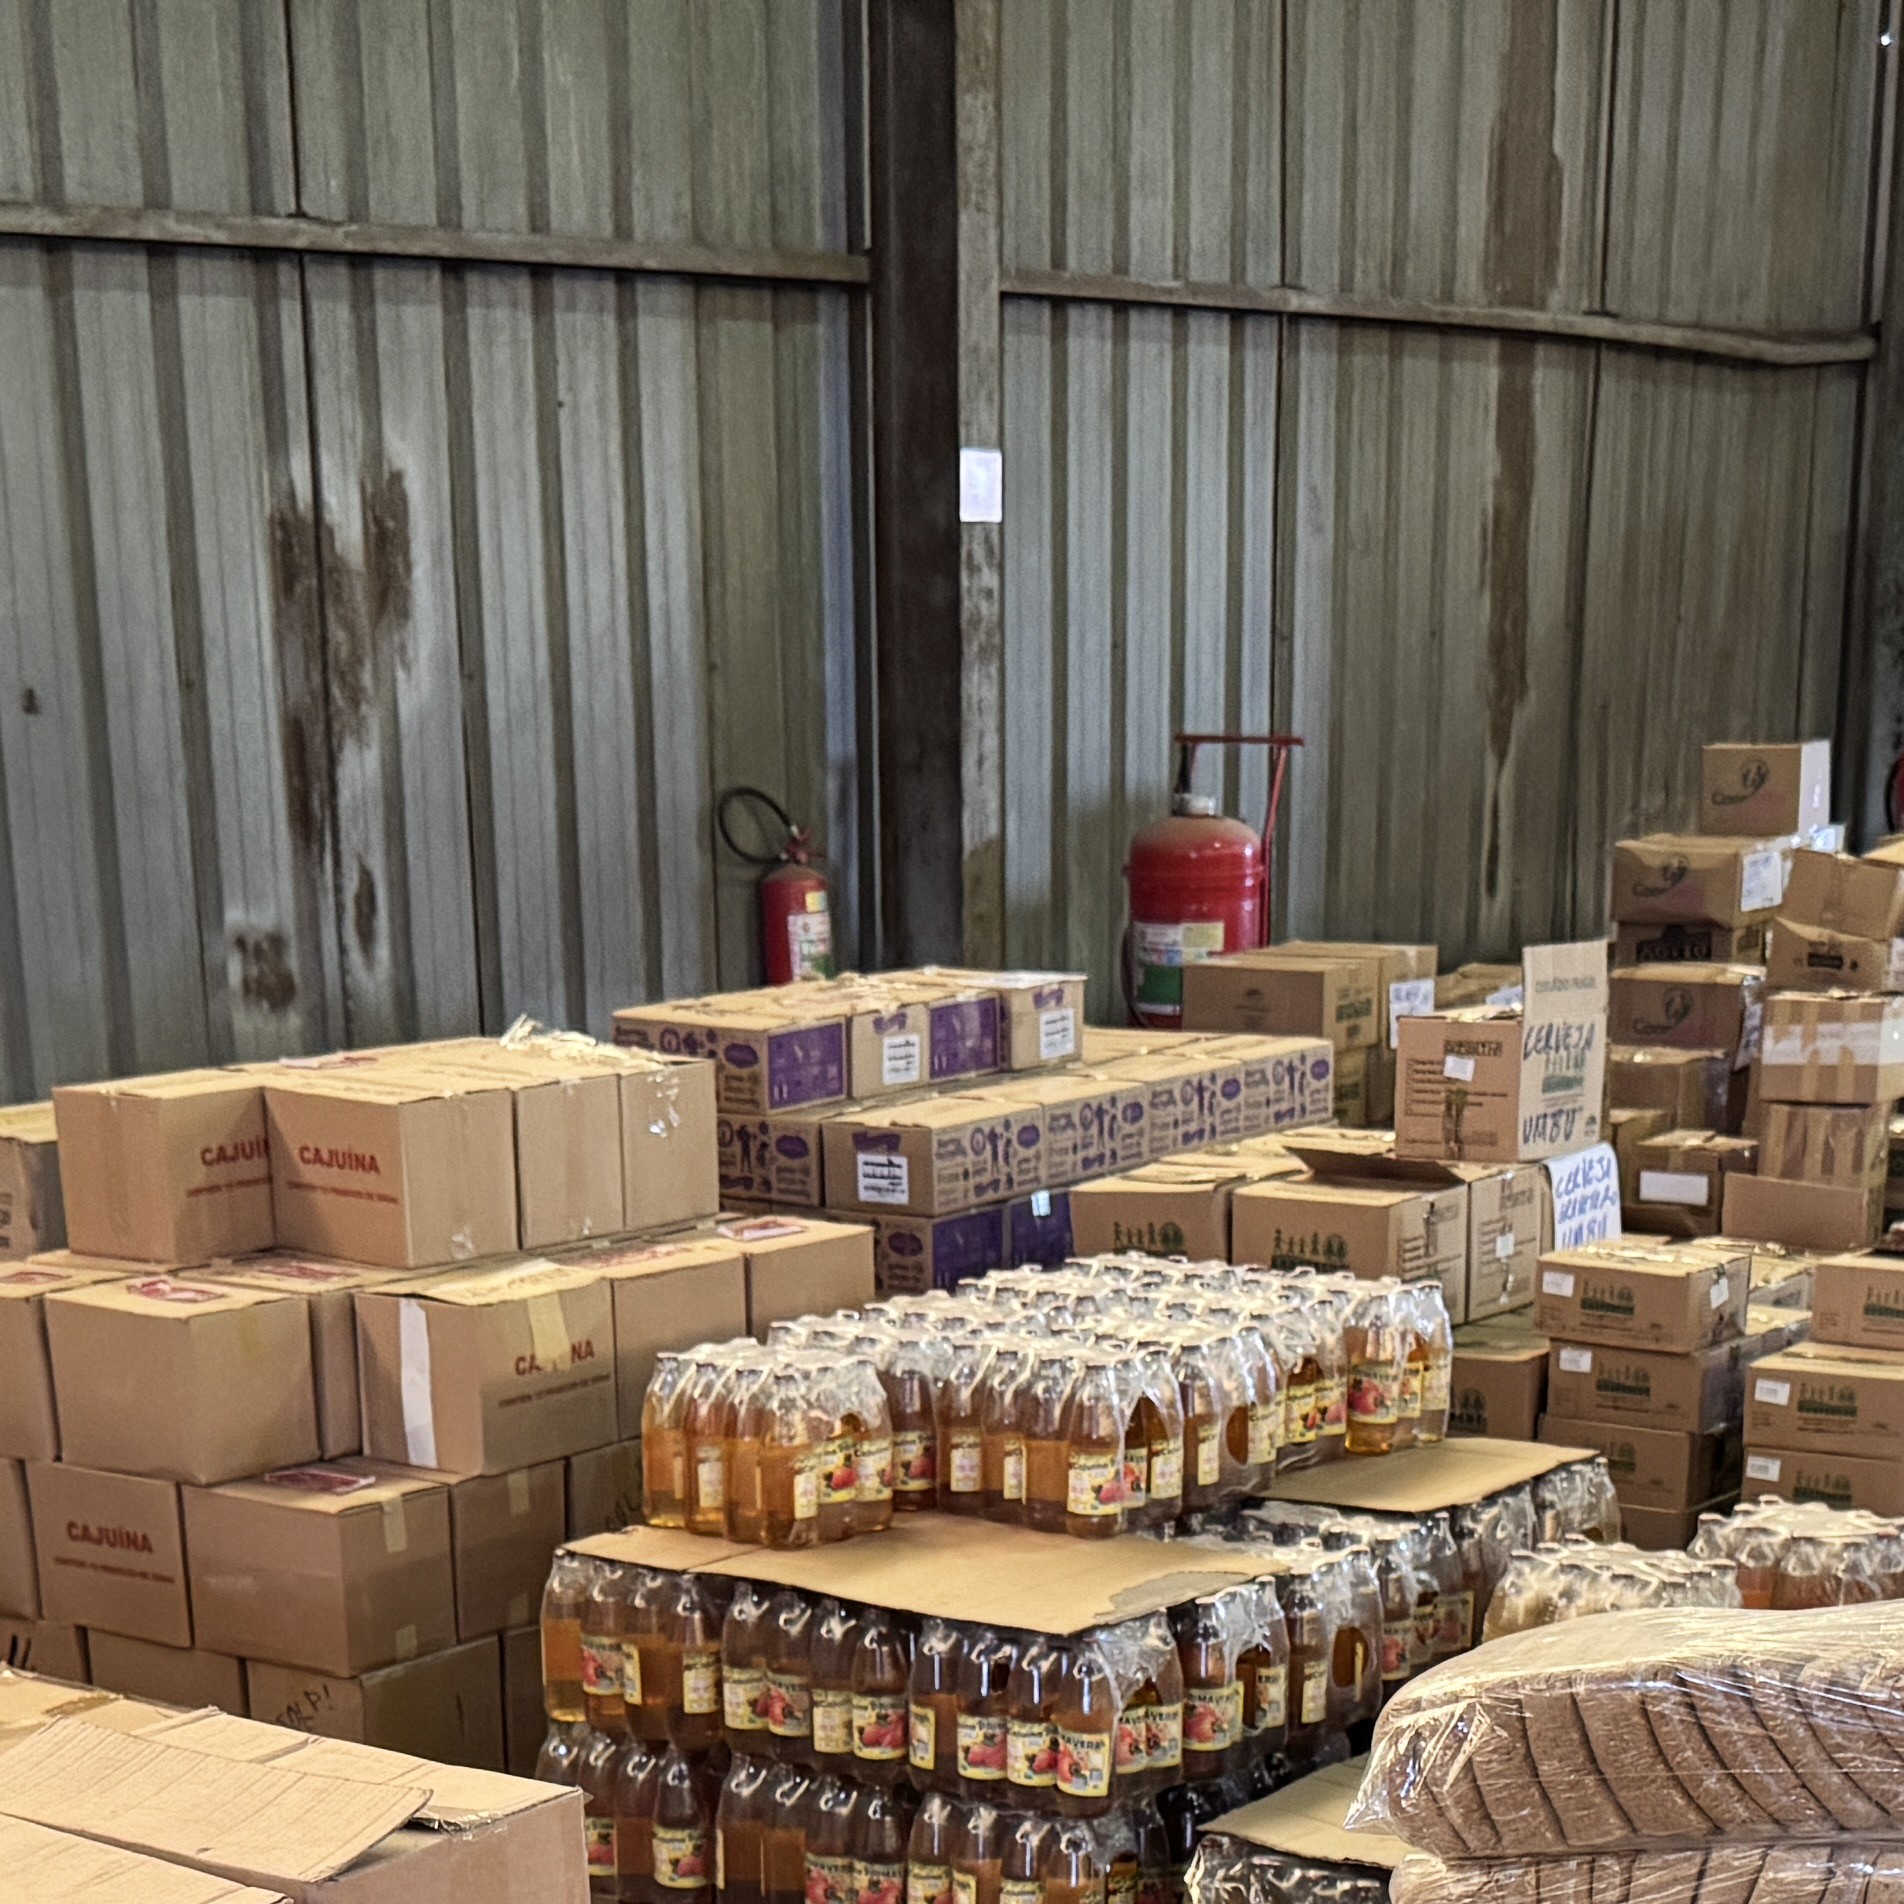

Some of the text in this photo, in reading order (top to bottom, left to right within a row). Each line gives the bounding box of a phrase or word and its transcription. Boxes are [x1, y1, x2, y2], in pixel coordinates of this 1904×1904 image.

[298, 1143, 381, 1176] CAJUÍNA
[514, 1338, 595, 1377] CANA
[66, 1520, 154, 1555] CAJUÍNA
